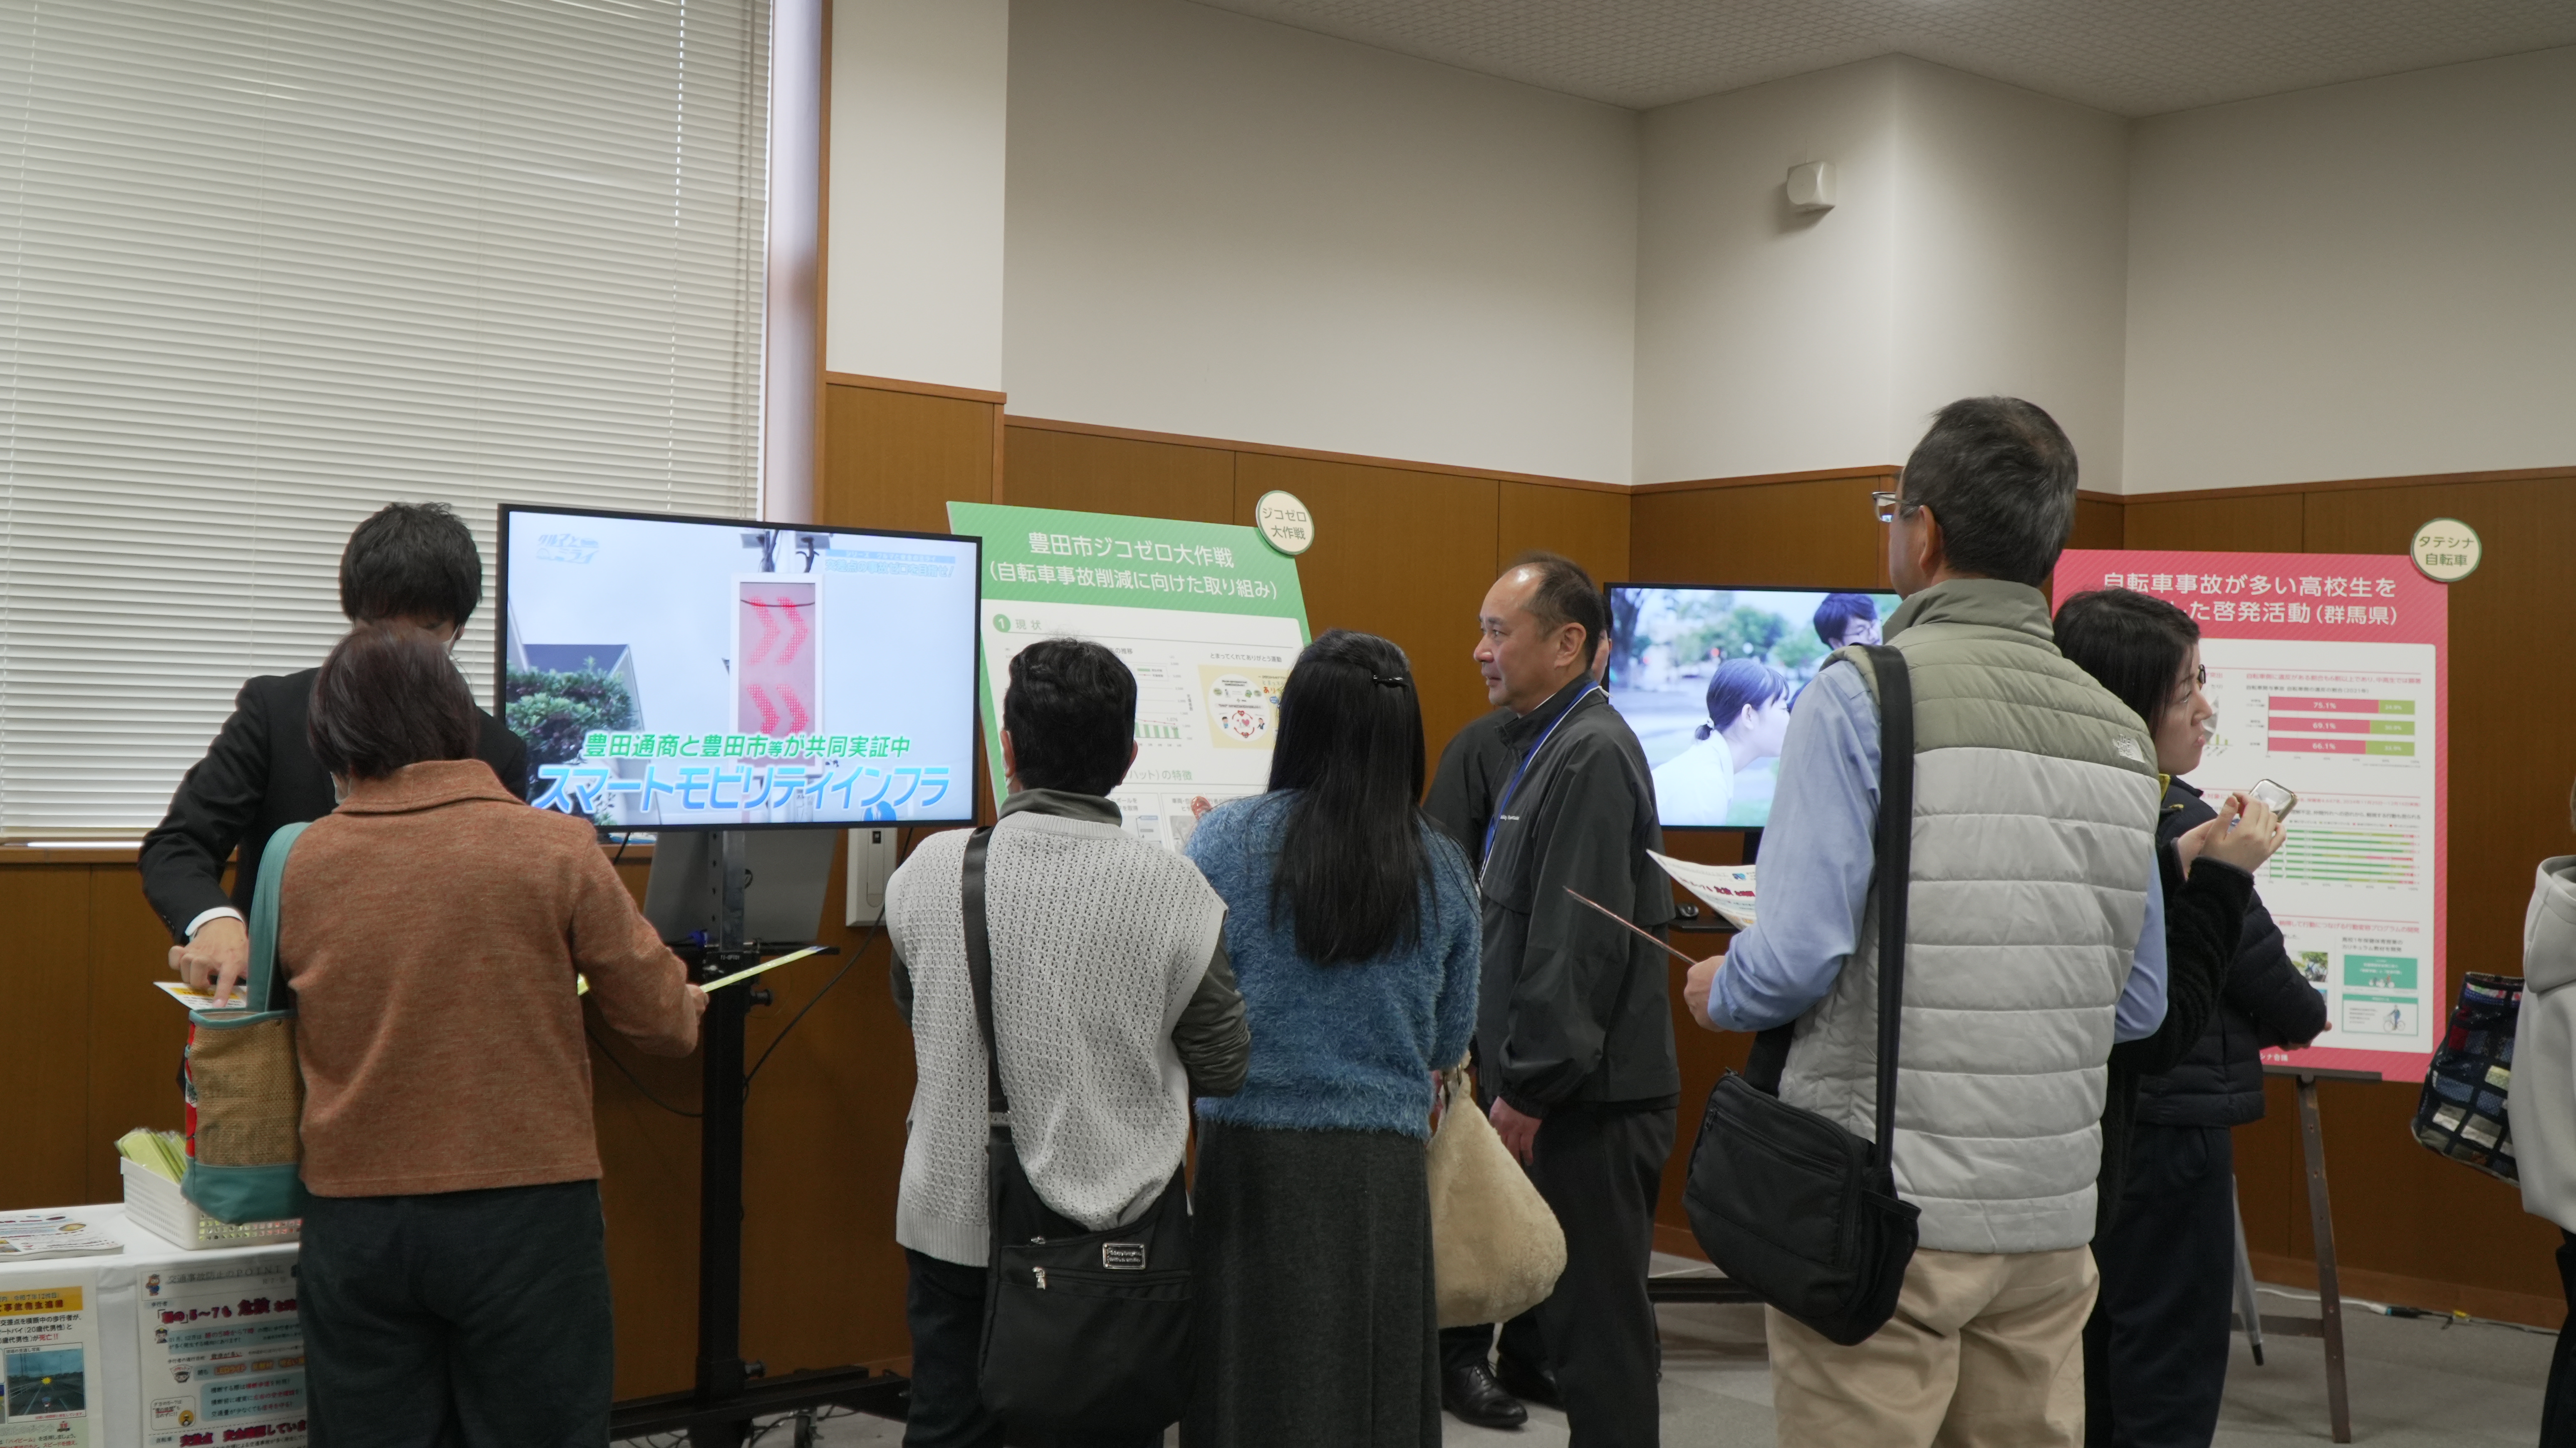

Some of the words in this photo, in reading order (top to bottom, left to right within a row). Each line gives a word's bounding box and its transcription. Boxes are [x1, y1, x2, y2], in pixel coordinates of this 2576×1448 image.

[1262, 506, 1307, 523] ジコゼロ
[1271, 525, 1306, 541] 大作戦
[1028, 532, 1234, 569] 豊田市ジコゼロ大作戦
[2418, 535, 2475, 550] タテシナ
[2425, 552, 2468, 568] 自転車
[989, 561, 1277, 600] (自転車事故削減に向けた取り組み)
[2103, 573, 2396, 598] 自転車事故が多い高校生を
[2171, 600, 2398, 626] た啓発活動(群馬県)
[1015, 619, 1042, 631] 現状
[1210, 653, 1282, 663] とまってくれてありがとう運動
[583, 732, 911, 759] 豊田通商と豊田市等が共同実証中
[1124, 769, 1193, 781] ハット)の特徴
[531, 765, 951, 813] スマートモビリティインフラ
[168, 1265, 281, 1284] 交通事故防止のPOINT
[0, 1314, 82, 1326] 交差点を横断中の歩行者が、
[0, 1324, 72, 1334] ートバイ(20歳代男性)と
